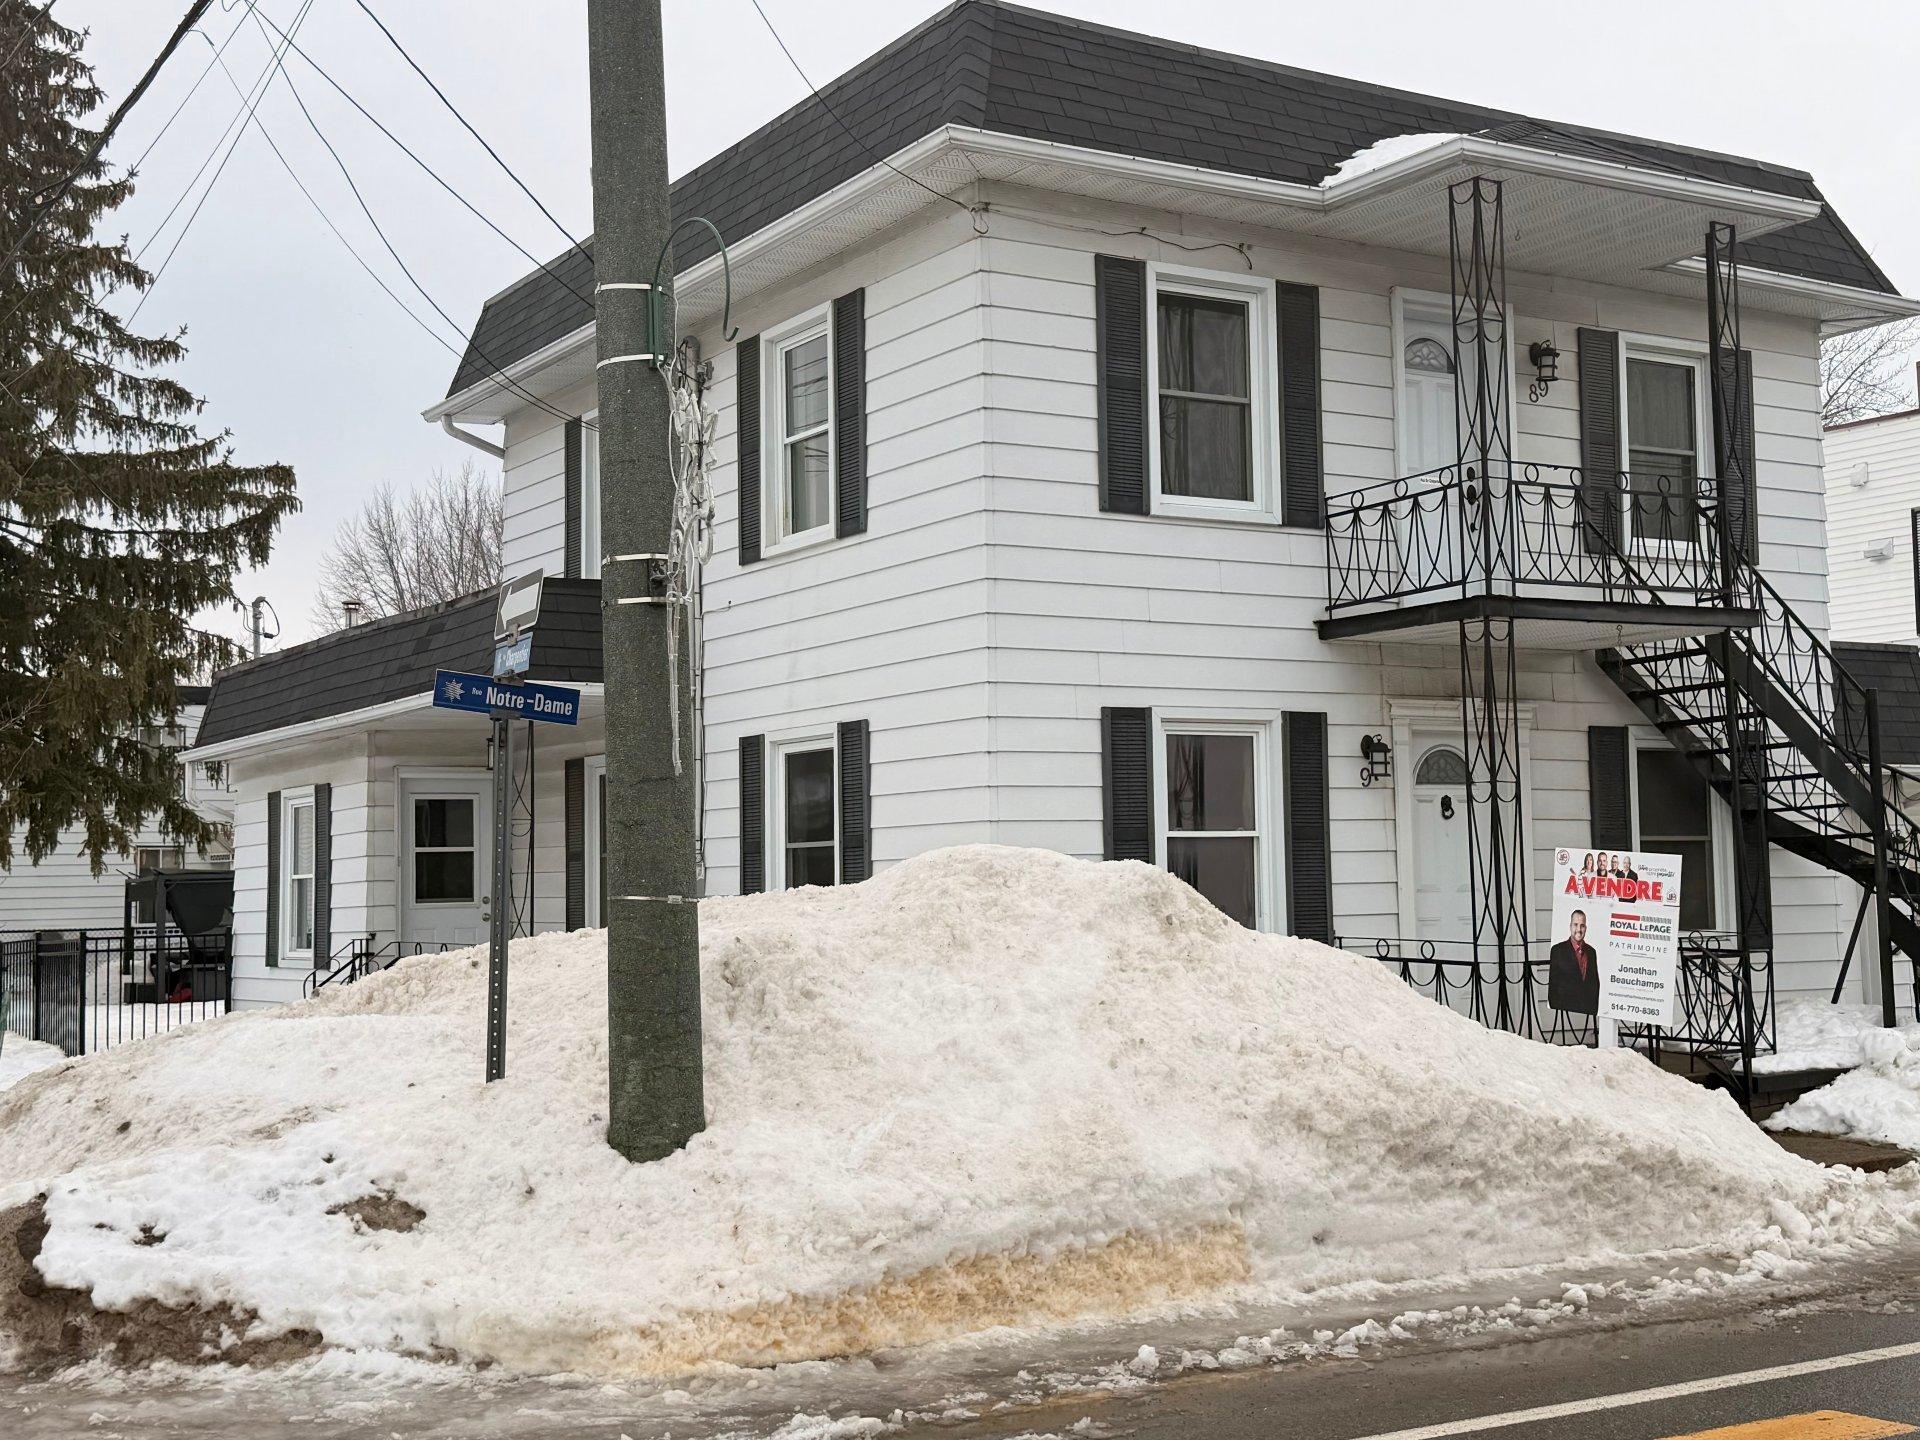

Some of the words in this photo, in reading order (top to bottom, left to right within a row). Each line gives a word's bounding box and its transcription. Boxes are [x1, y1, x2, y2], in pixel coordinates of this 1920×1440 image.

[1529, 380, 1549, 403] 89
[485, 686, 573, 716] Notre-Dame
[1581, 876, 1663, 901] VENDRE
[1609, 920, 1638, 931] ROYAL
[1609, 941, 1668, 954] PATRIMOINE
[1618, 964, 1658, 977] Jonathan
[1610, 974, 1665, 990] Beauchamps
